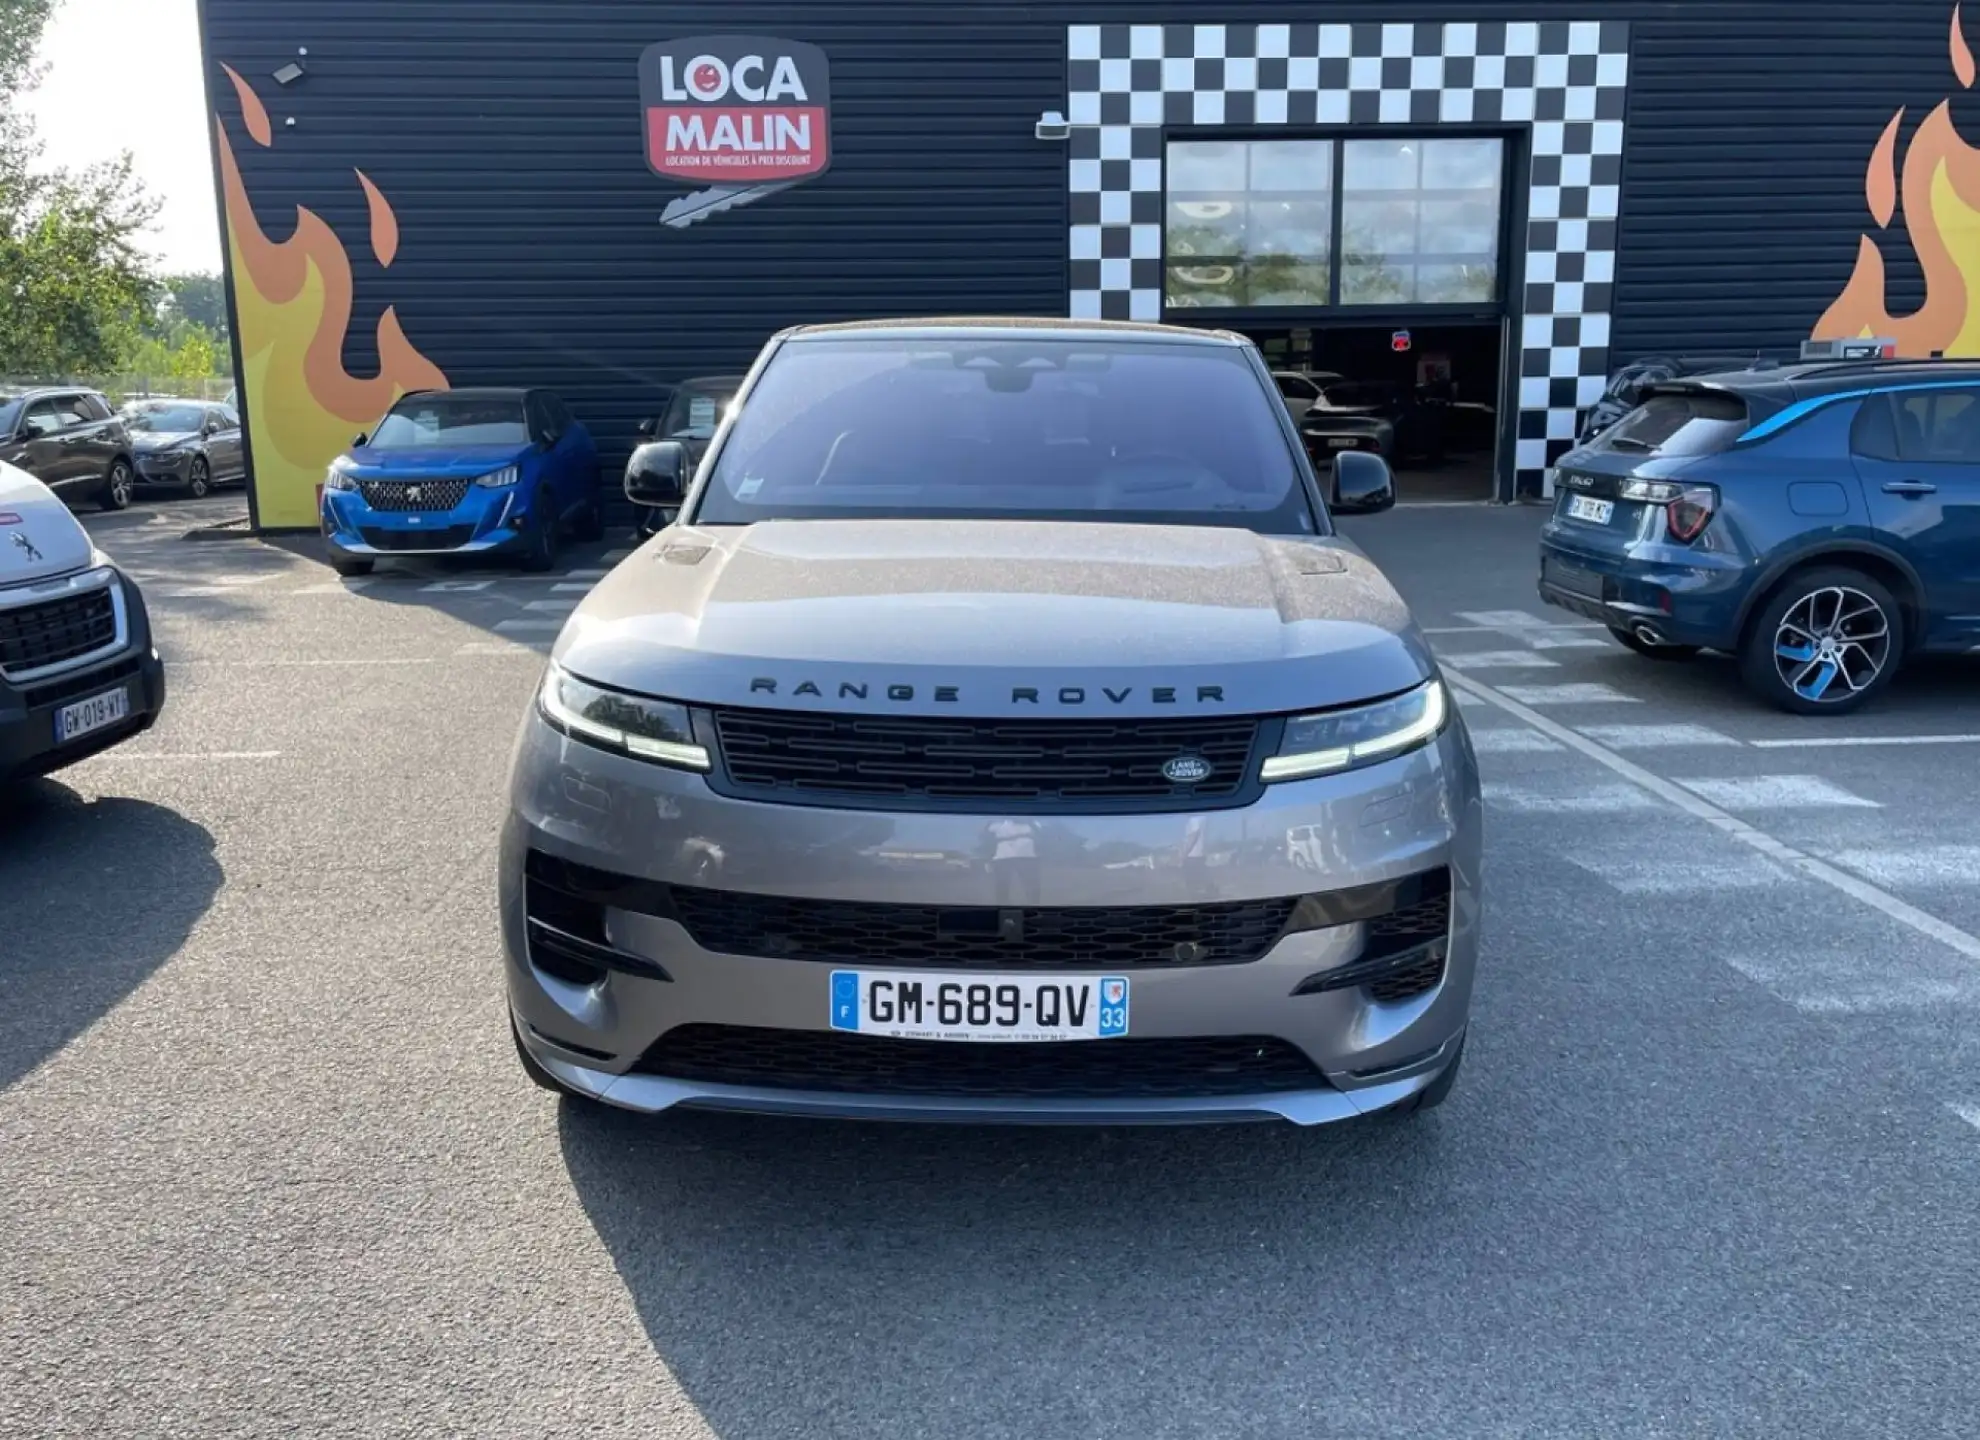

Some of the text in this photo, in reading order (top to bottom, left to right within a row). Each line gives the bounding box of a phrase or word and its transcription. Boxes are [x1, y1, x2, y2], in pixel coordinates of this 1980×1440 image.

[660, 54, 808, 102] LOCA
[665, 114, 812, 152] MALIN
[665, 154, 700, 167] LOCATION
[702, 154, 712, 167] DE
[758, 154, 775, 166] PRIX
[776, 154, 811, 167] DISCOUNT
[749, 676, 1226, 705] RANGE ROVER
[840, 1005, 850, 1018] F
[868, 980, 1090, 1028] GM-689-QV
[1100, 1007, 1125, 1028] 33
